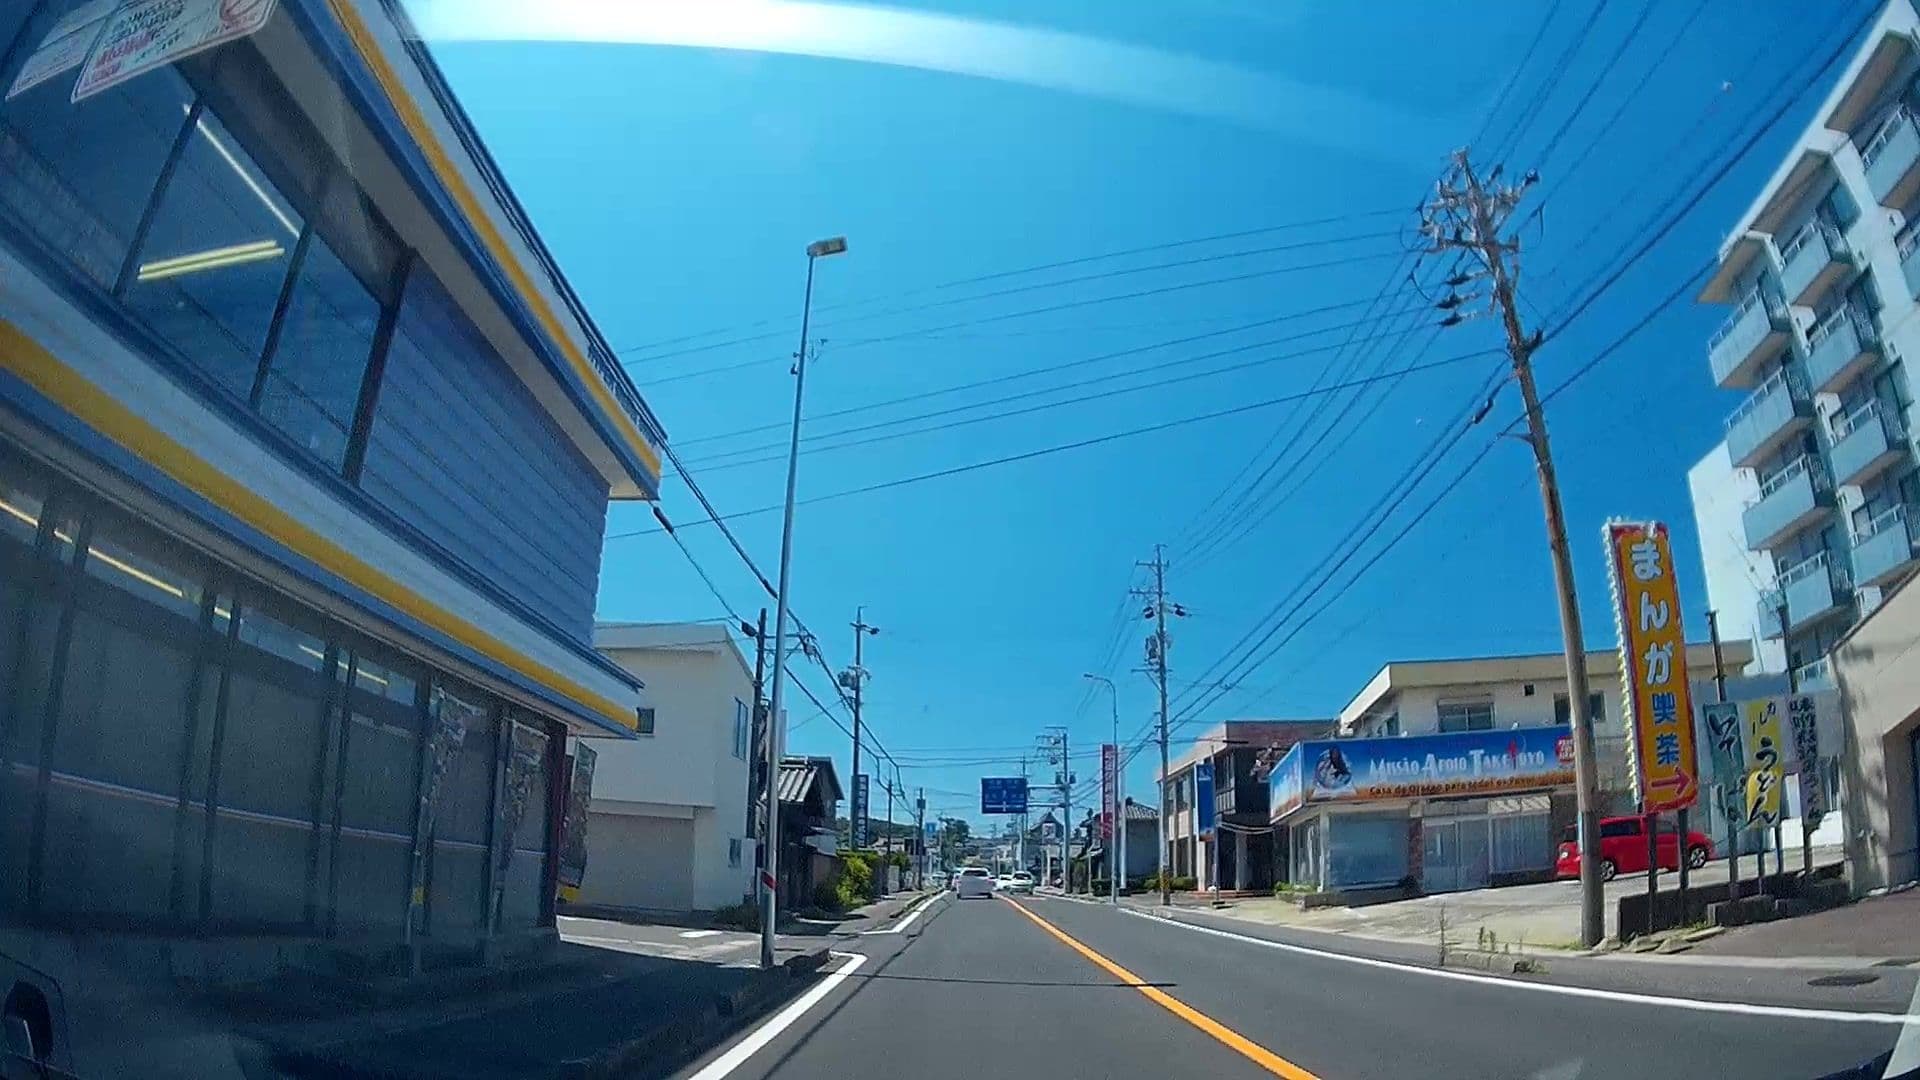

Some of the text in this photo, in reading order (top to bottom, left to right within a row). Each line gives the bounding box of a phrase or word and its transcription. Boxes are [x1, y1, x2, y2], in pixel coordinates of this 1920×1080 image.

[1631, 539, 1681, 766] まんが喫茶
